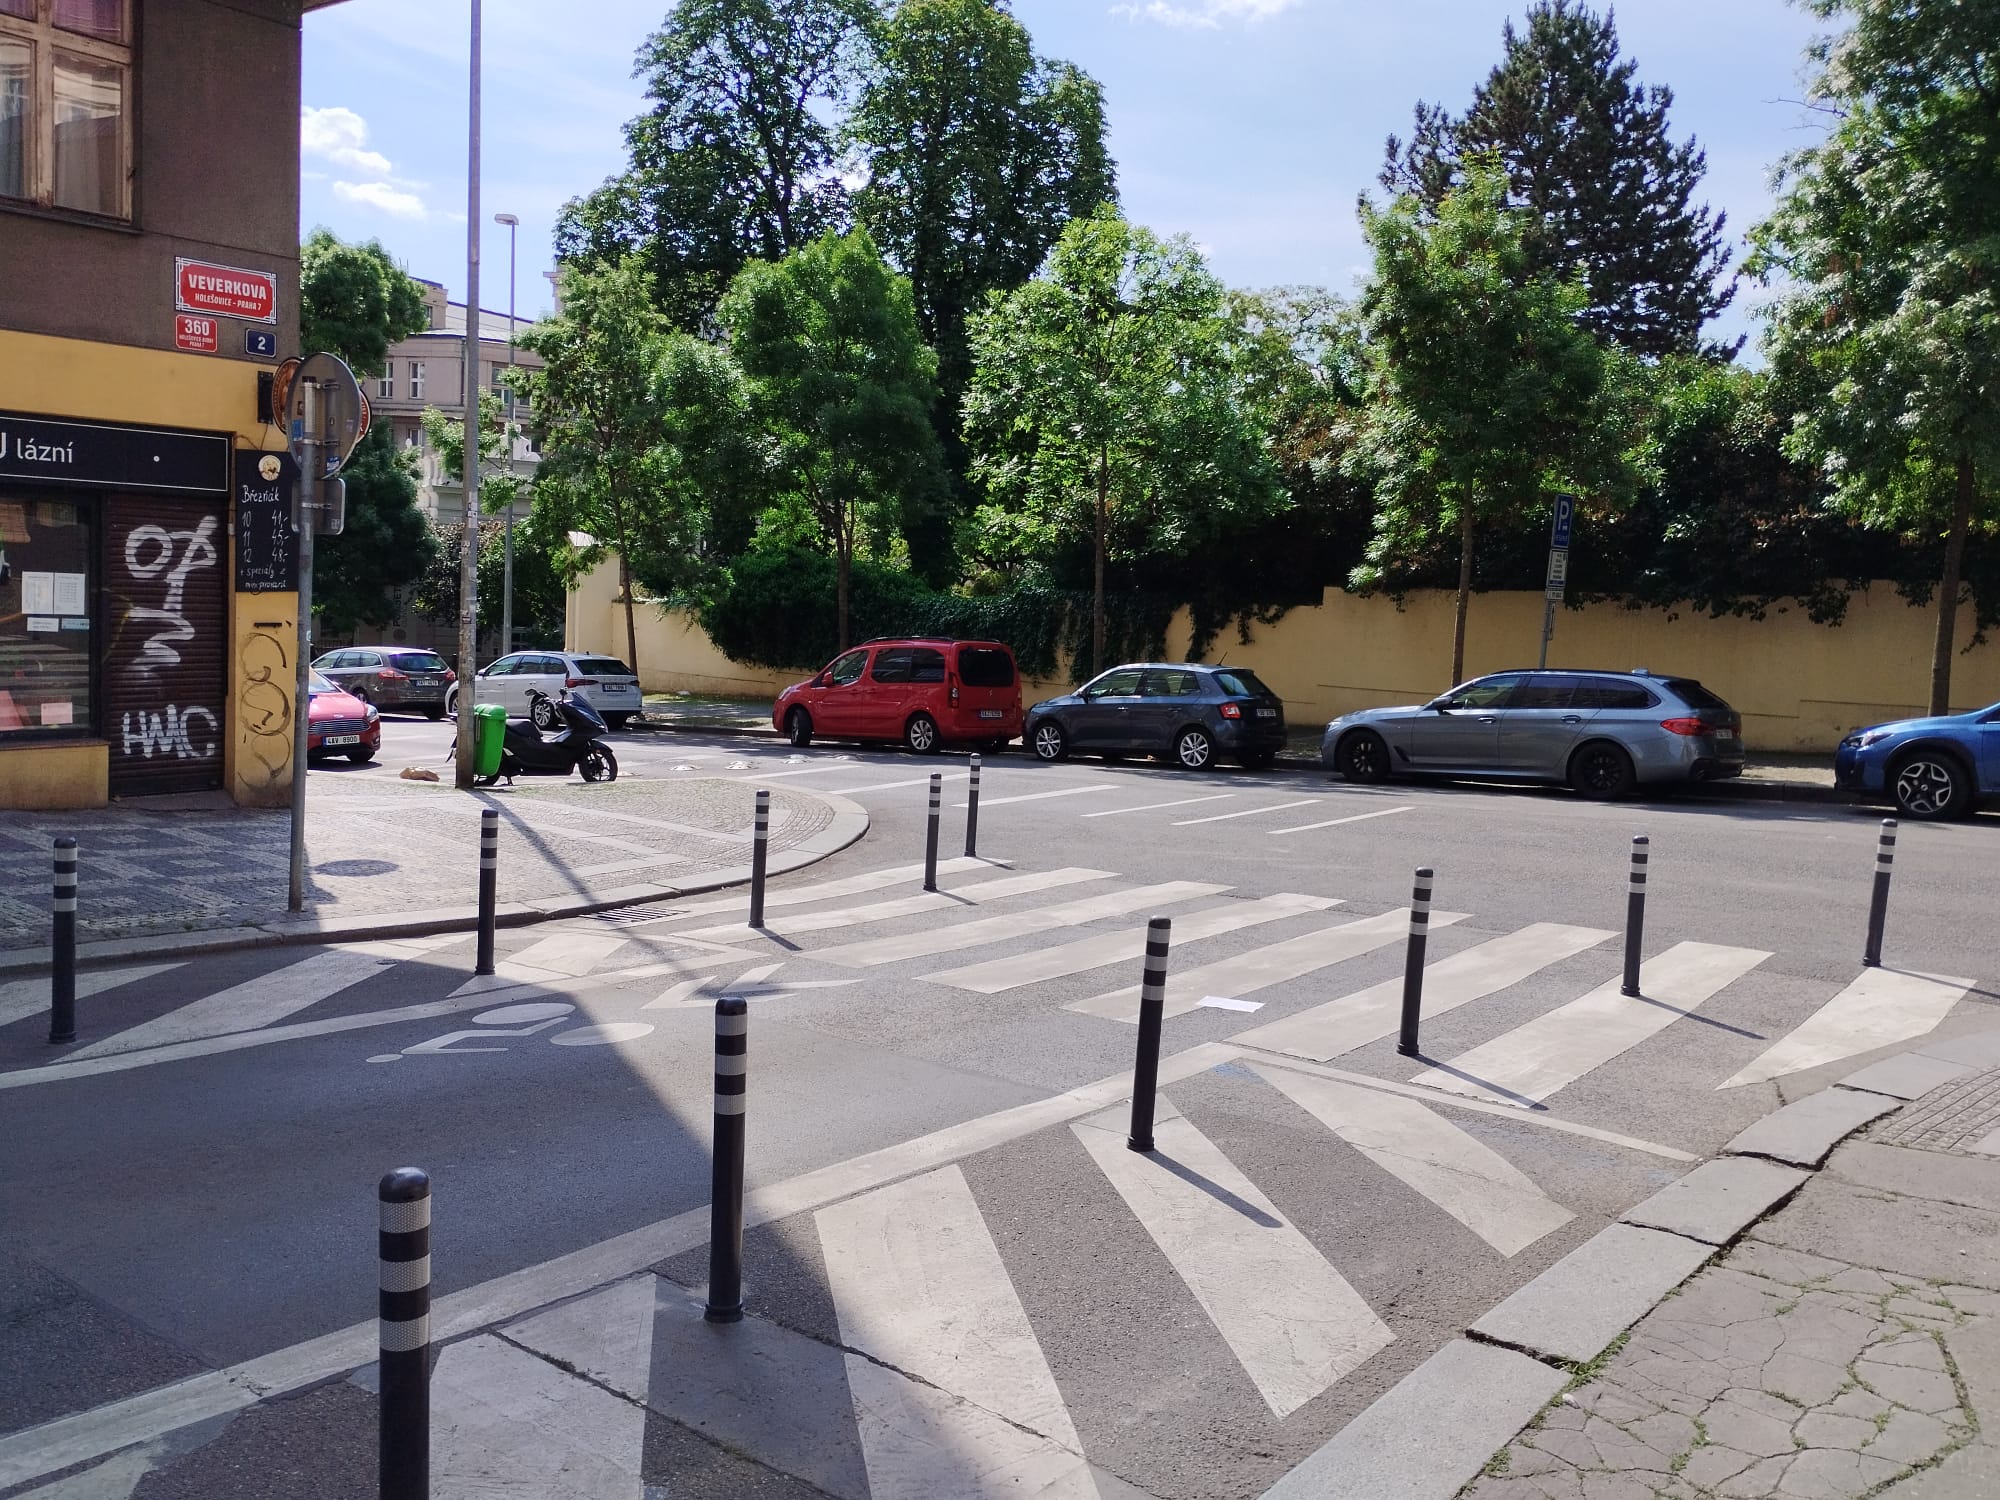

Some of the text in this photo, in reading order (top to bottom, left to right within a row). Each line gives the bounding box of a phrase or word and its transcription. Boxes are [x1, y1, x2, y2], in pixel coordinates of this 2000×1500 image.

[188, 273, 267, 300] VEVERKOVA
[195, 293, 232, 306] HOLEŠOVICE
[237, 300, 257, 311] PRAHA
[257, 303, 262, 311] 7
[184, 319, 210, 336] 360
[257, 336, 266, 350] 2
[17, 438, 74, 463] lázní
[242, 511, 252, 528] 10
[1557, 500, 1570, 531] P
[243, 530, 251, 547] 11
[243, 548, 252, 563] 12
